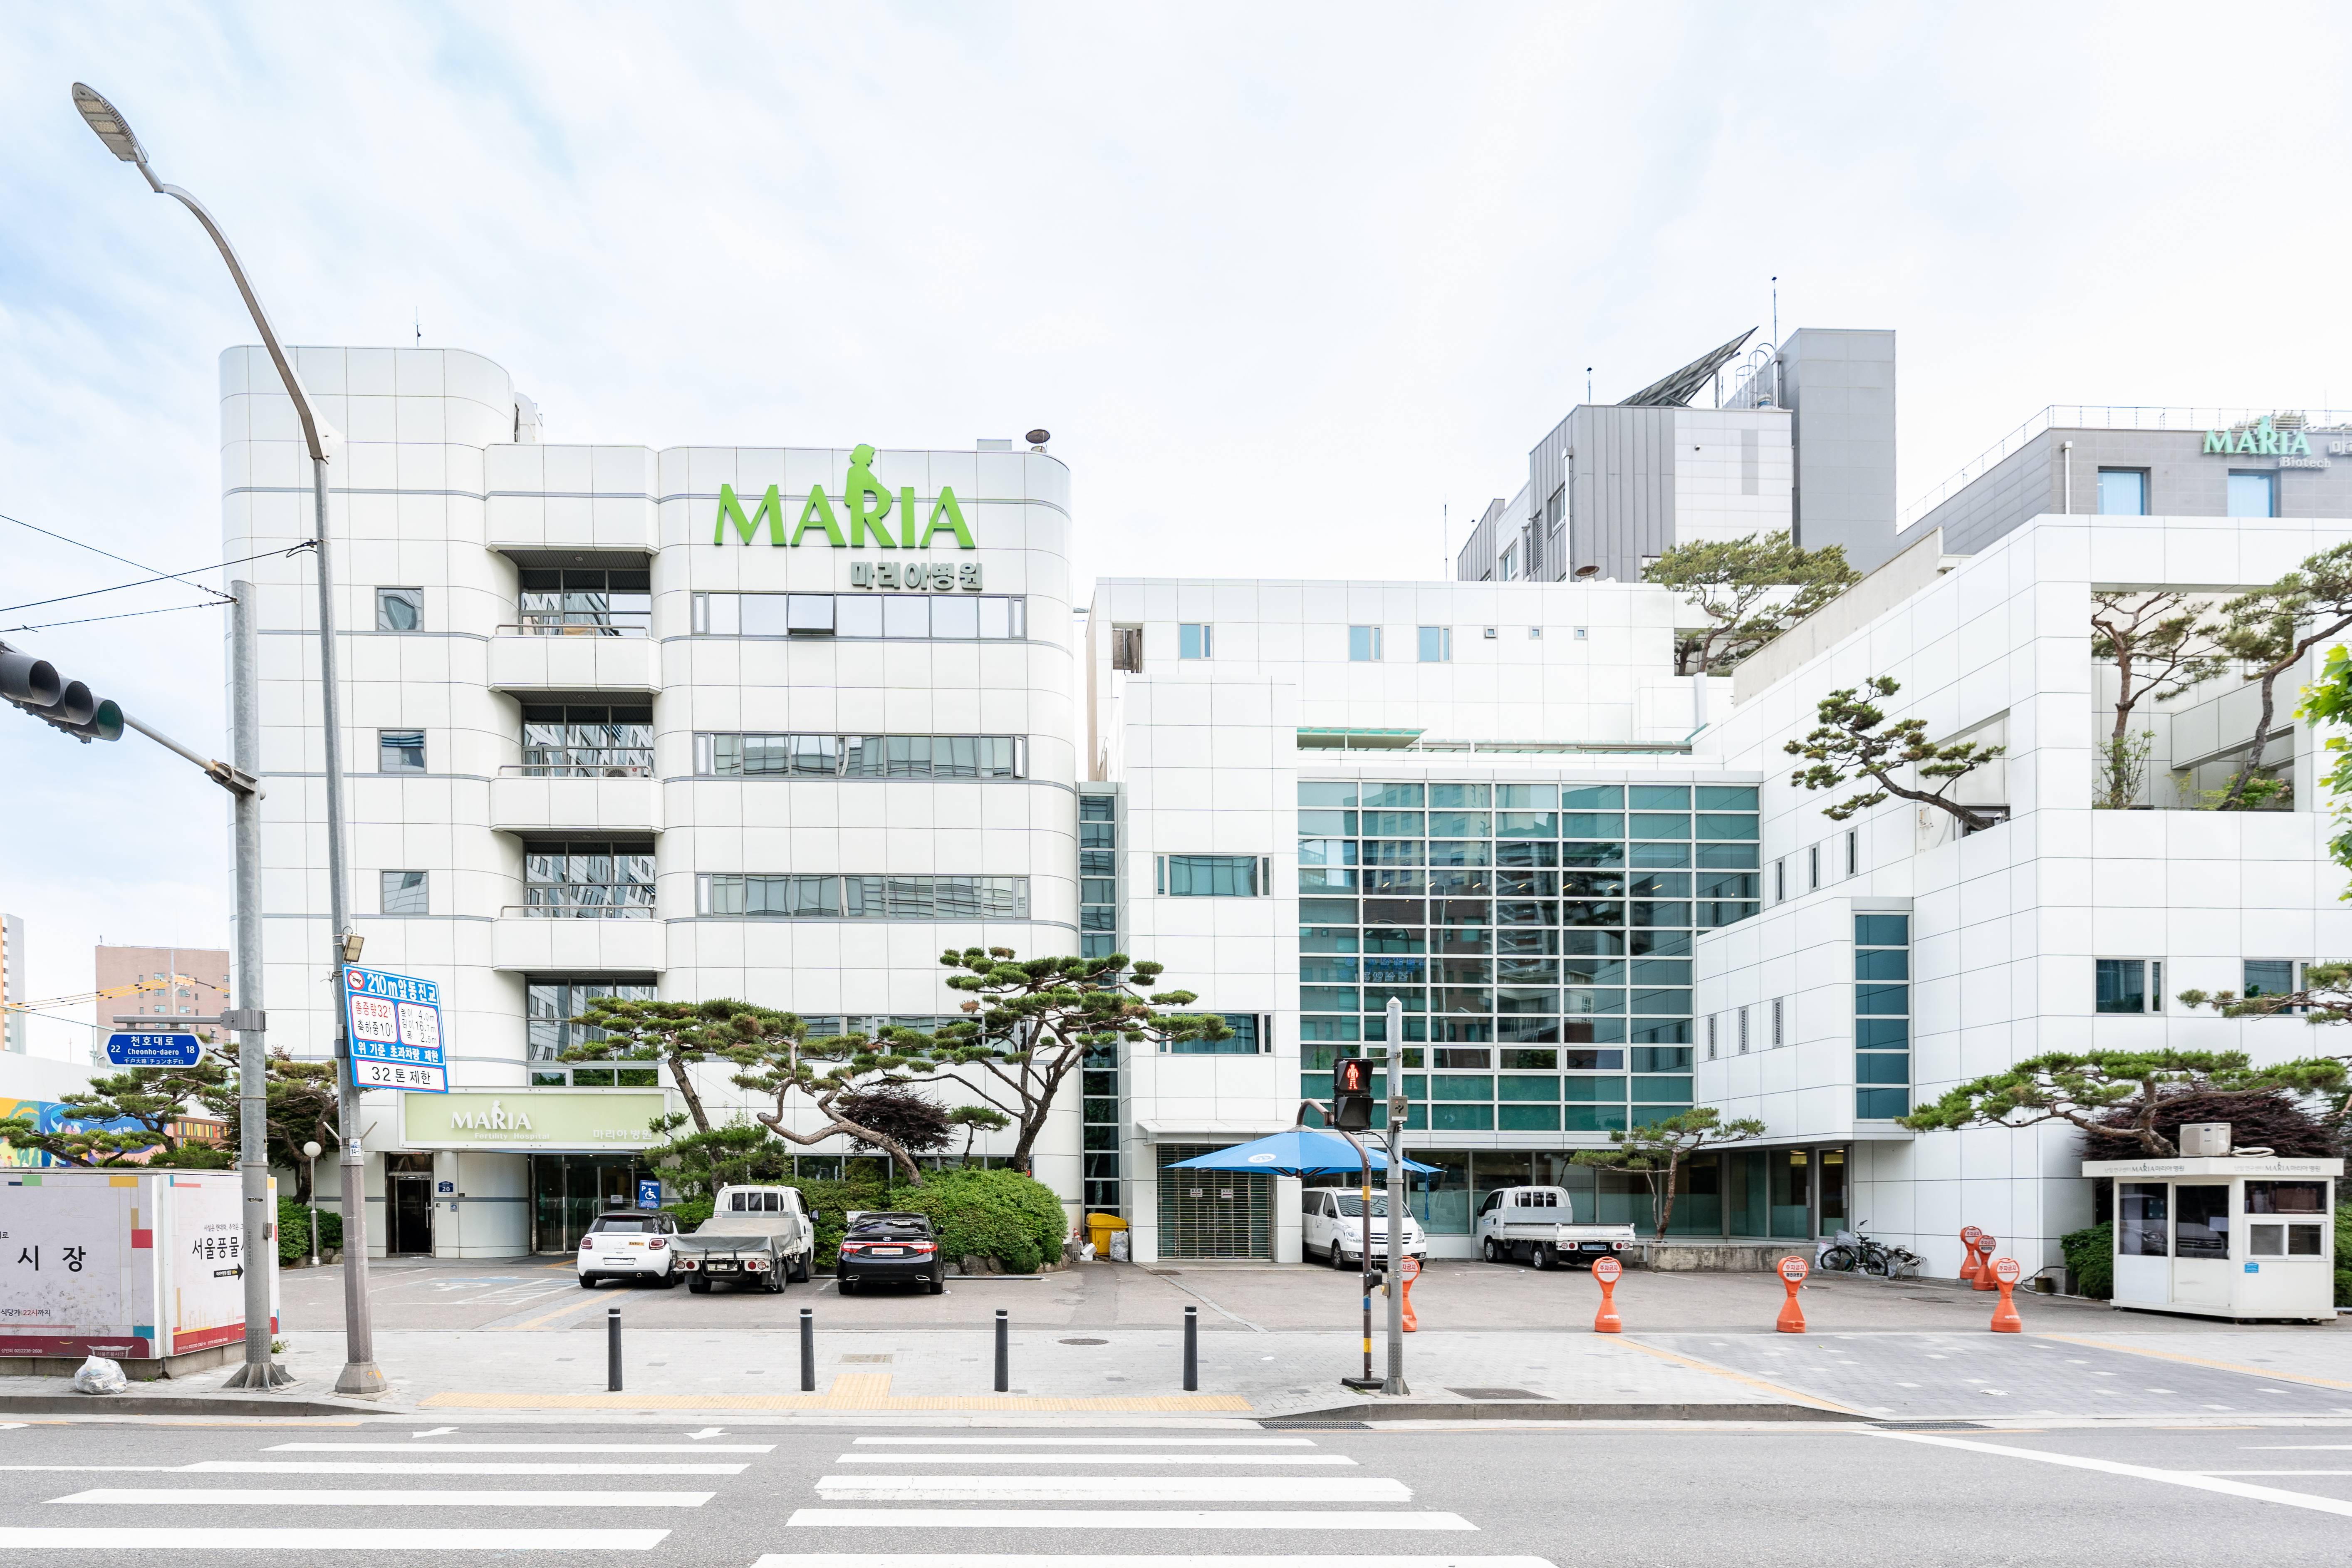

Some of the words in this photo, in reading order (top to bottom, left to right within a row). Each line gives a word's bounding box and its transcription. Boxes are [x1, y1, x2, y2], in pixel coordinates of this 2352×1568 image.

[2203, 429, 2312, 456] MARIA
[2279, 456, 2331, 468] Biotech
[714, 483, 975, 549] MARIA
[851, 562, 983, 590] 마리아병원
[131, 1036, 174, 1047] 천호대로
[358, 1041, 366, 1054] 위
[369, 1043, 386, 1057] 기준
[424, 1050, 438, 1062] 제한
[451, 1111, 532, 1130] MARIA
[192, 1237, 243, 1260] 서울풍물
